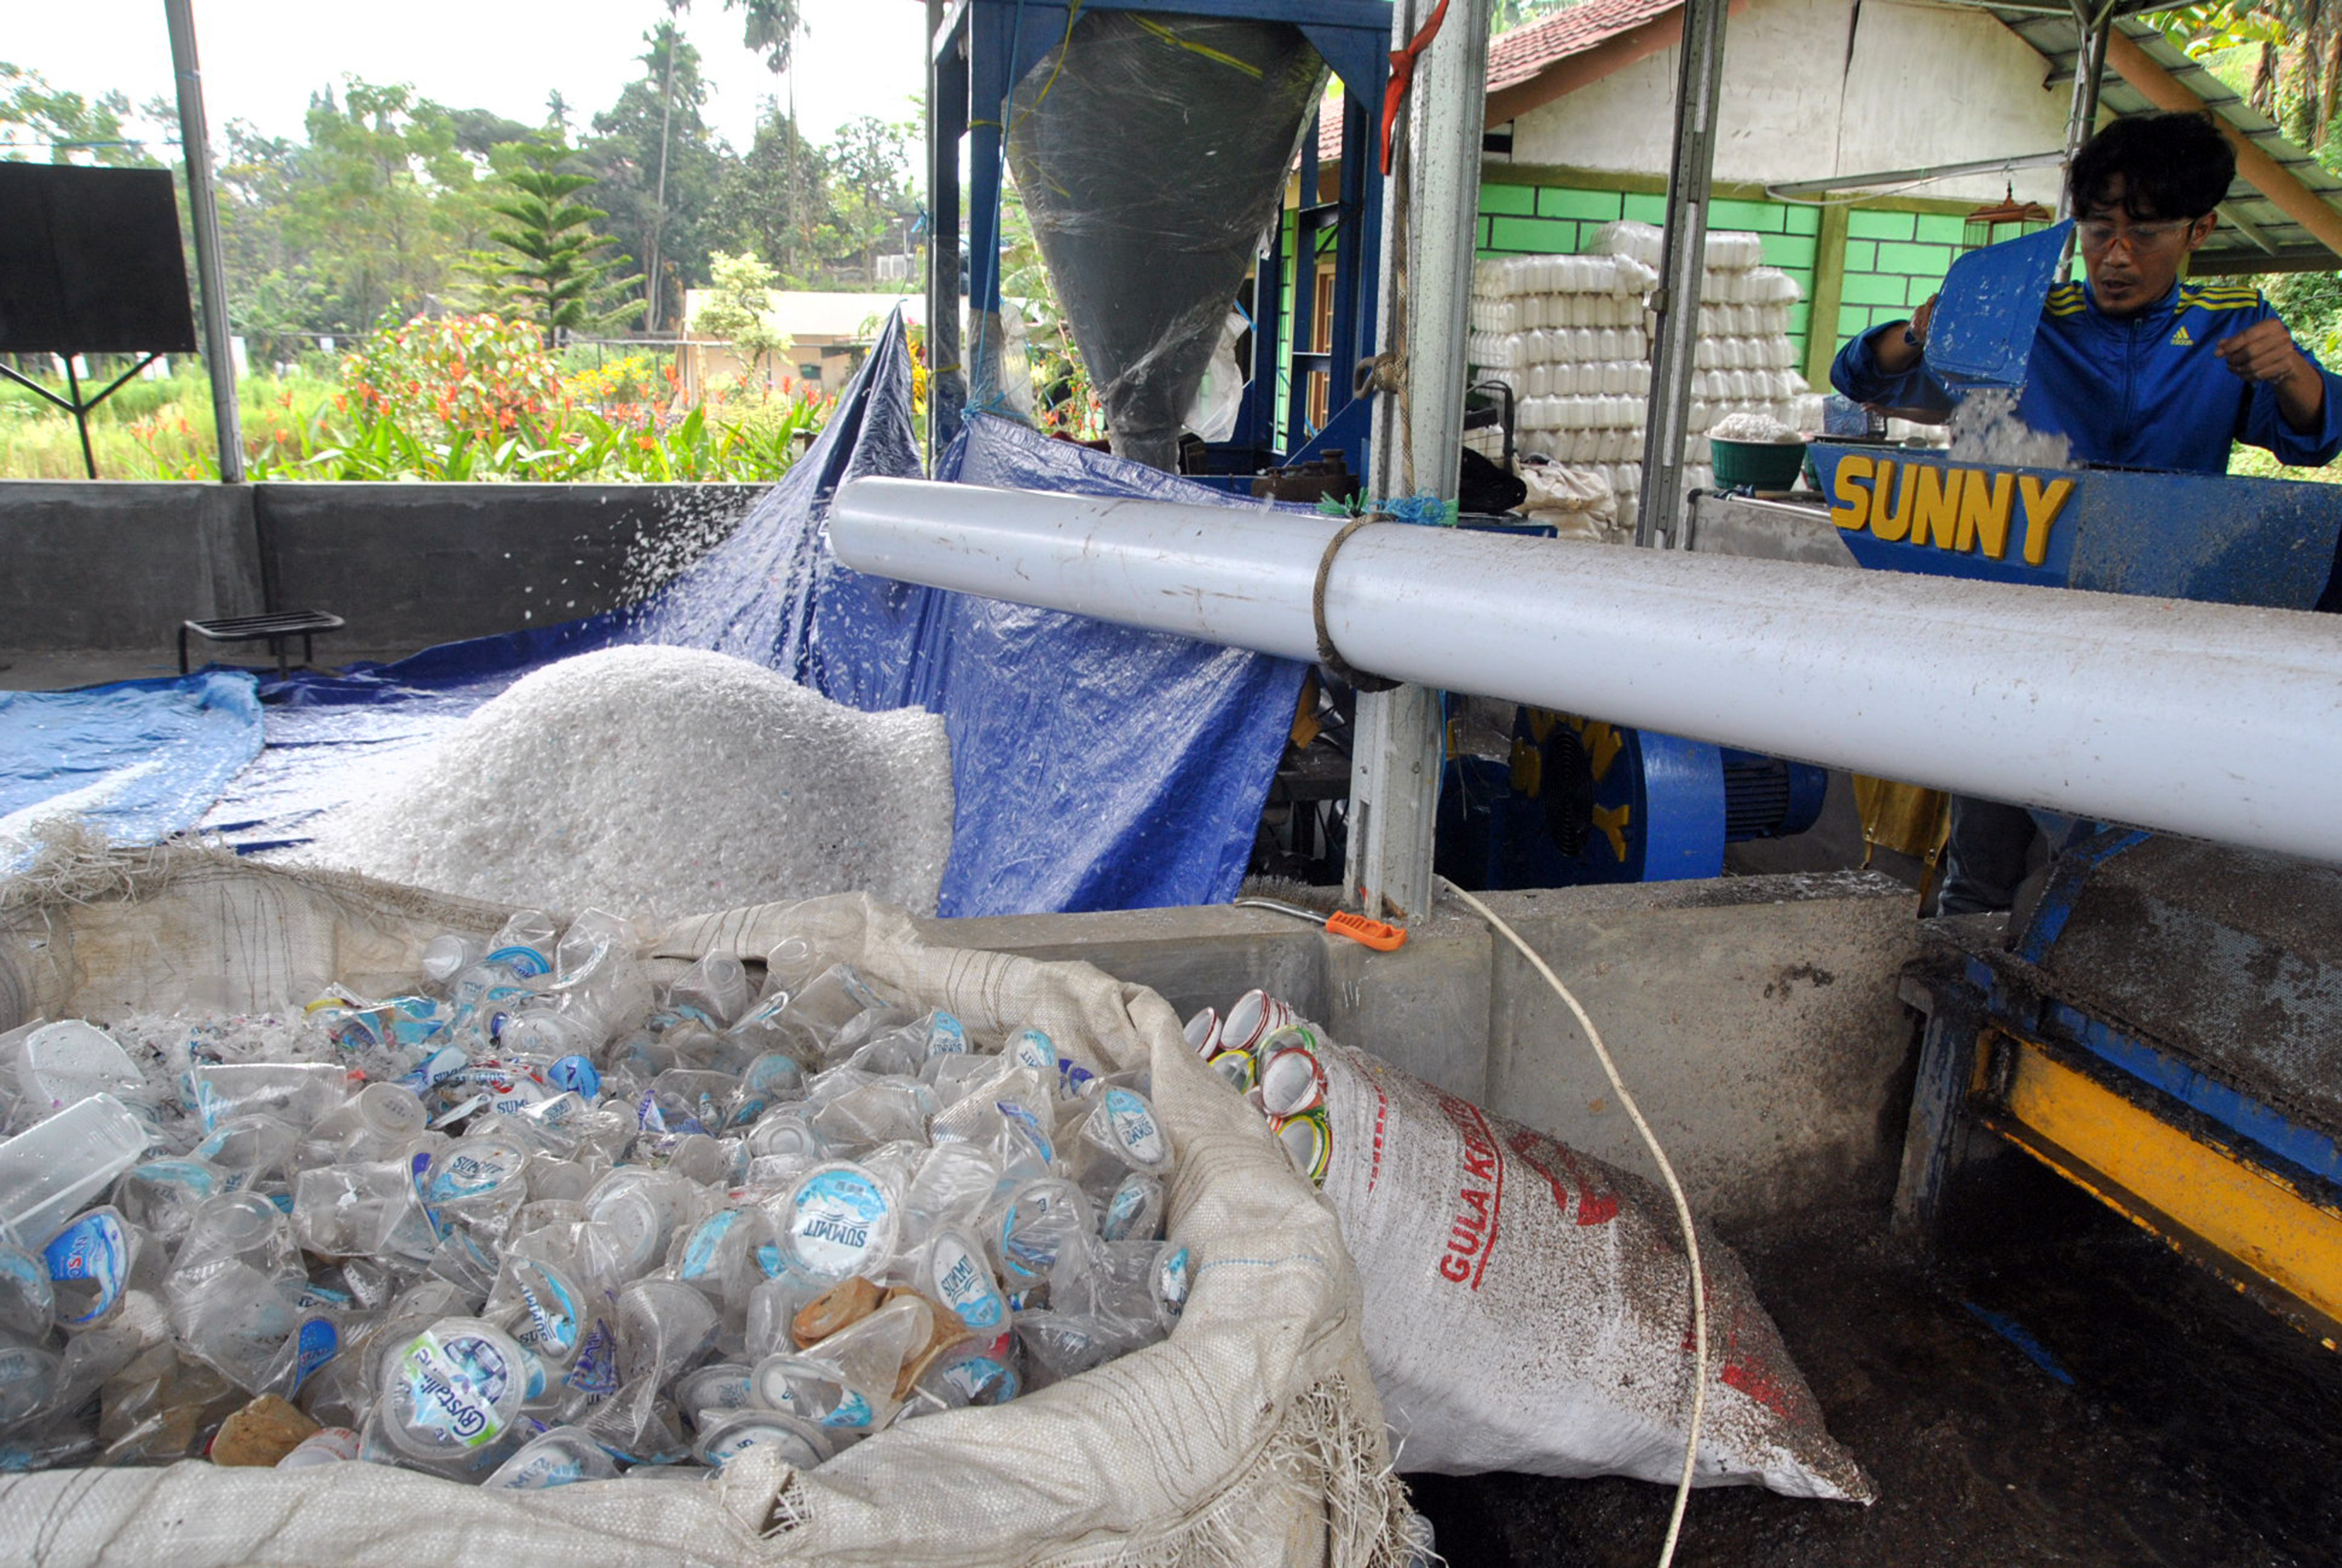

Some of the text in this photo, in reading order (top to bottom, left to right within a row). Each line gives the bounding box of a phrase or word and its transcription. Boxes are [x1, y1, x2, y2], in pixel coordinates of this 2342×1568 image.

[1831, 455, 2076, 567] SUNNY
[453, 1156, 505, 1175] SUMMIT
[803, 1218, 868, 1248] SUMMIT
[1440, 1189, 1491, 1283] GULA
